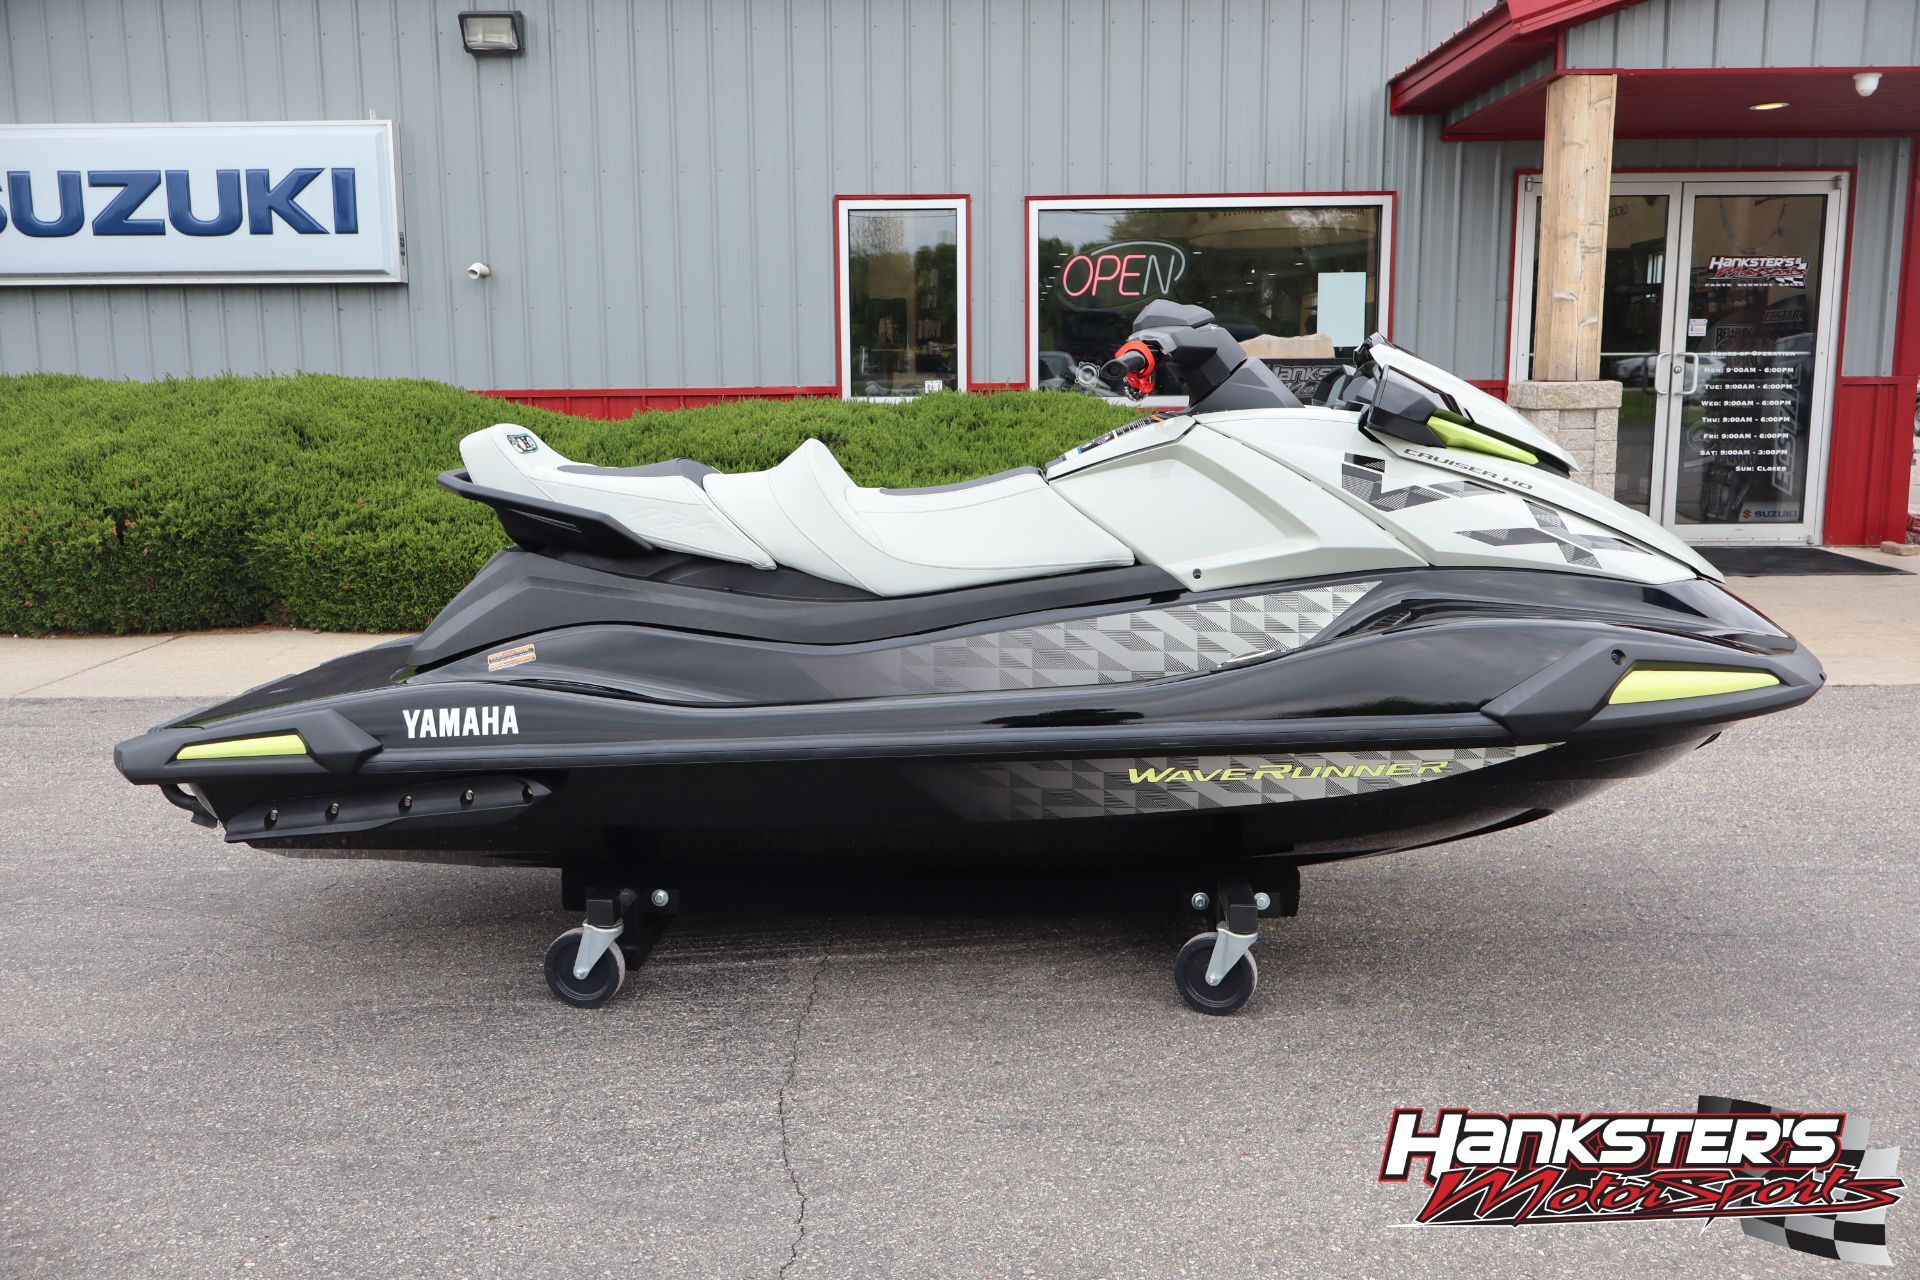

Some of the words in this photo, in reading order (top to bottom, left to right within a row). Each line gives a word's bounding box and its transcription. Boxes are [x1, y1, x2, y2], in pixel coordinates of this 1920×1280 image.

[0, 167, 359, 238] UZUKI
[1062, 254, 1176, 297] OPEN
[1403, 448, 1498, 478] CRUISER
[1502, 477, 1533, 489] HO
[403, 705, 519, 738] YAMAHA
[1128, 761, 1449, 784] WAVERUNNER
